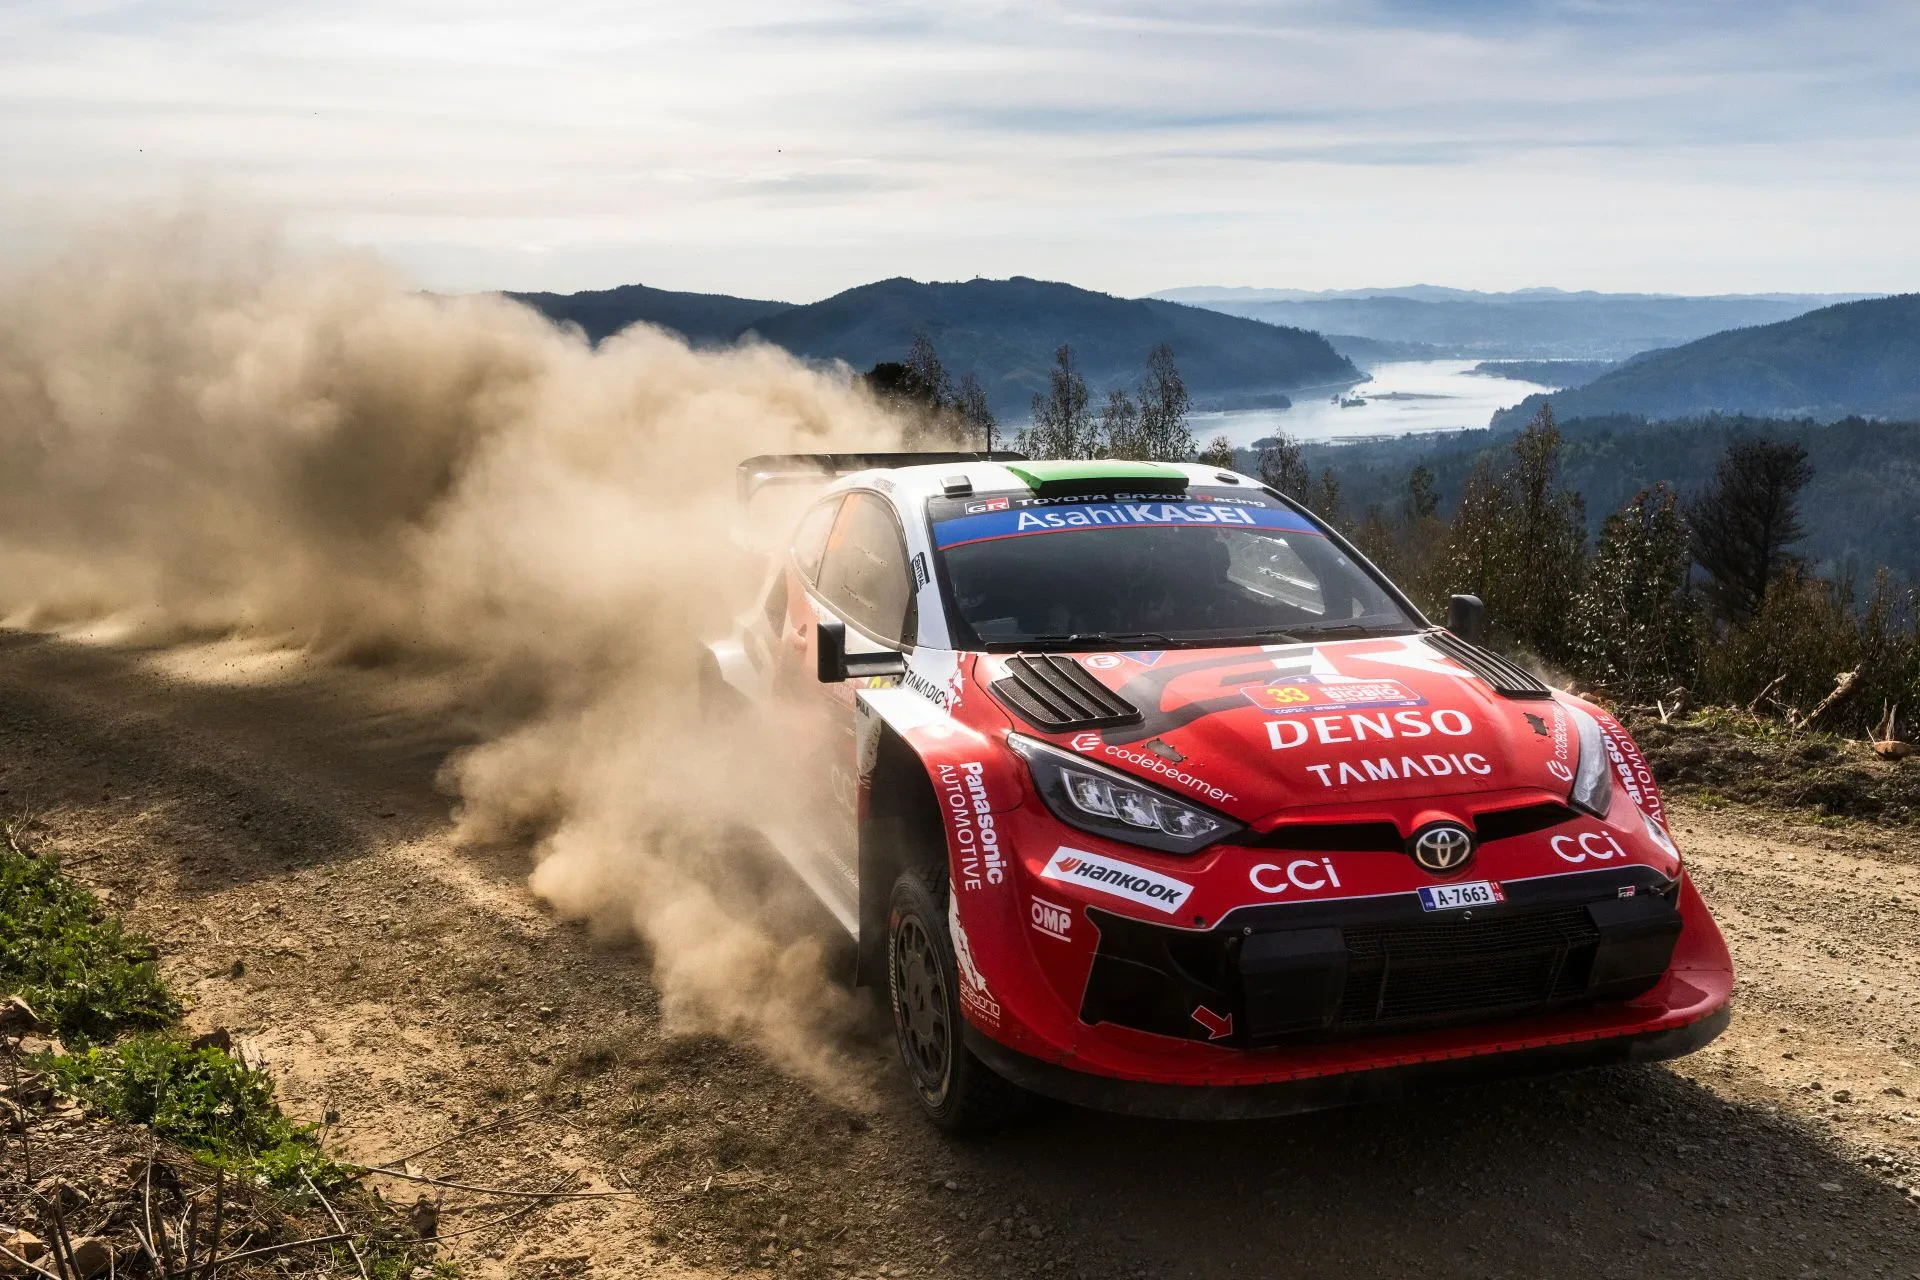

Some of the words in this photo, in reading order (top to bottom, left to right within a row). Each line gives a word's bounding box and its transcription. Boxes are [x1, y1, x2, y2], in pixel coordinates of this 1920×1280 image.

[965, 499, 1009, 515] GR
[1016, 494, 1107, 506] TOYOTA
[1114, 492, 1192, 501] GAZOO
[1195, 495, 1267, 509] Racing
[904, 669, 946, 705] TAMADIC
[1266, 687, 1311, 703] 33
[1264, 709, 1473, 750] DENSO
[1105, 745, 1235, 803] codebeamer
[1305, 753, 1492, 787] TAMADIC
[1596, 715, 1664, 823] AUTOMOTIVE
[937, 764, 982, 891] AUTOMOTIVE
[960, 761, 1007, 885] Panasonic
[1437, 885, 1490, 906] A-7663
[1491, 882, 1499, 890] 11
[1031, 904, 1072, 936] OMP
